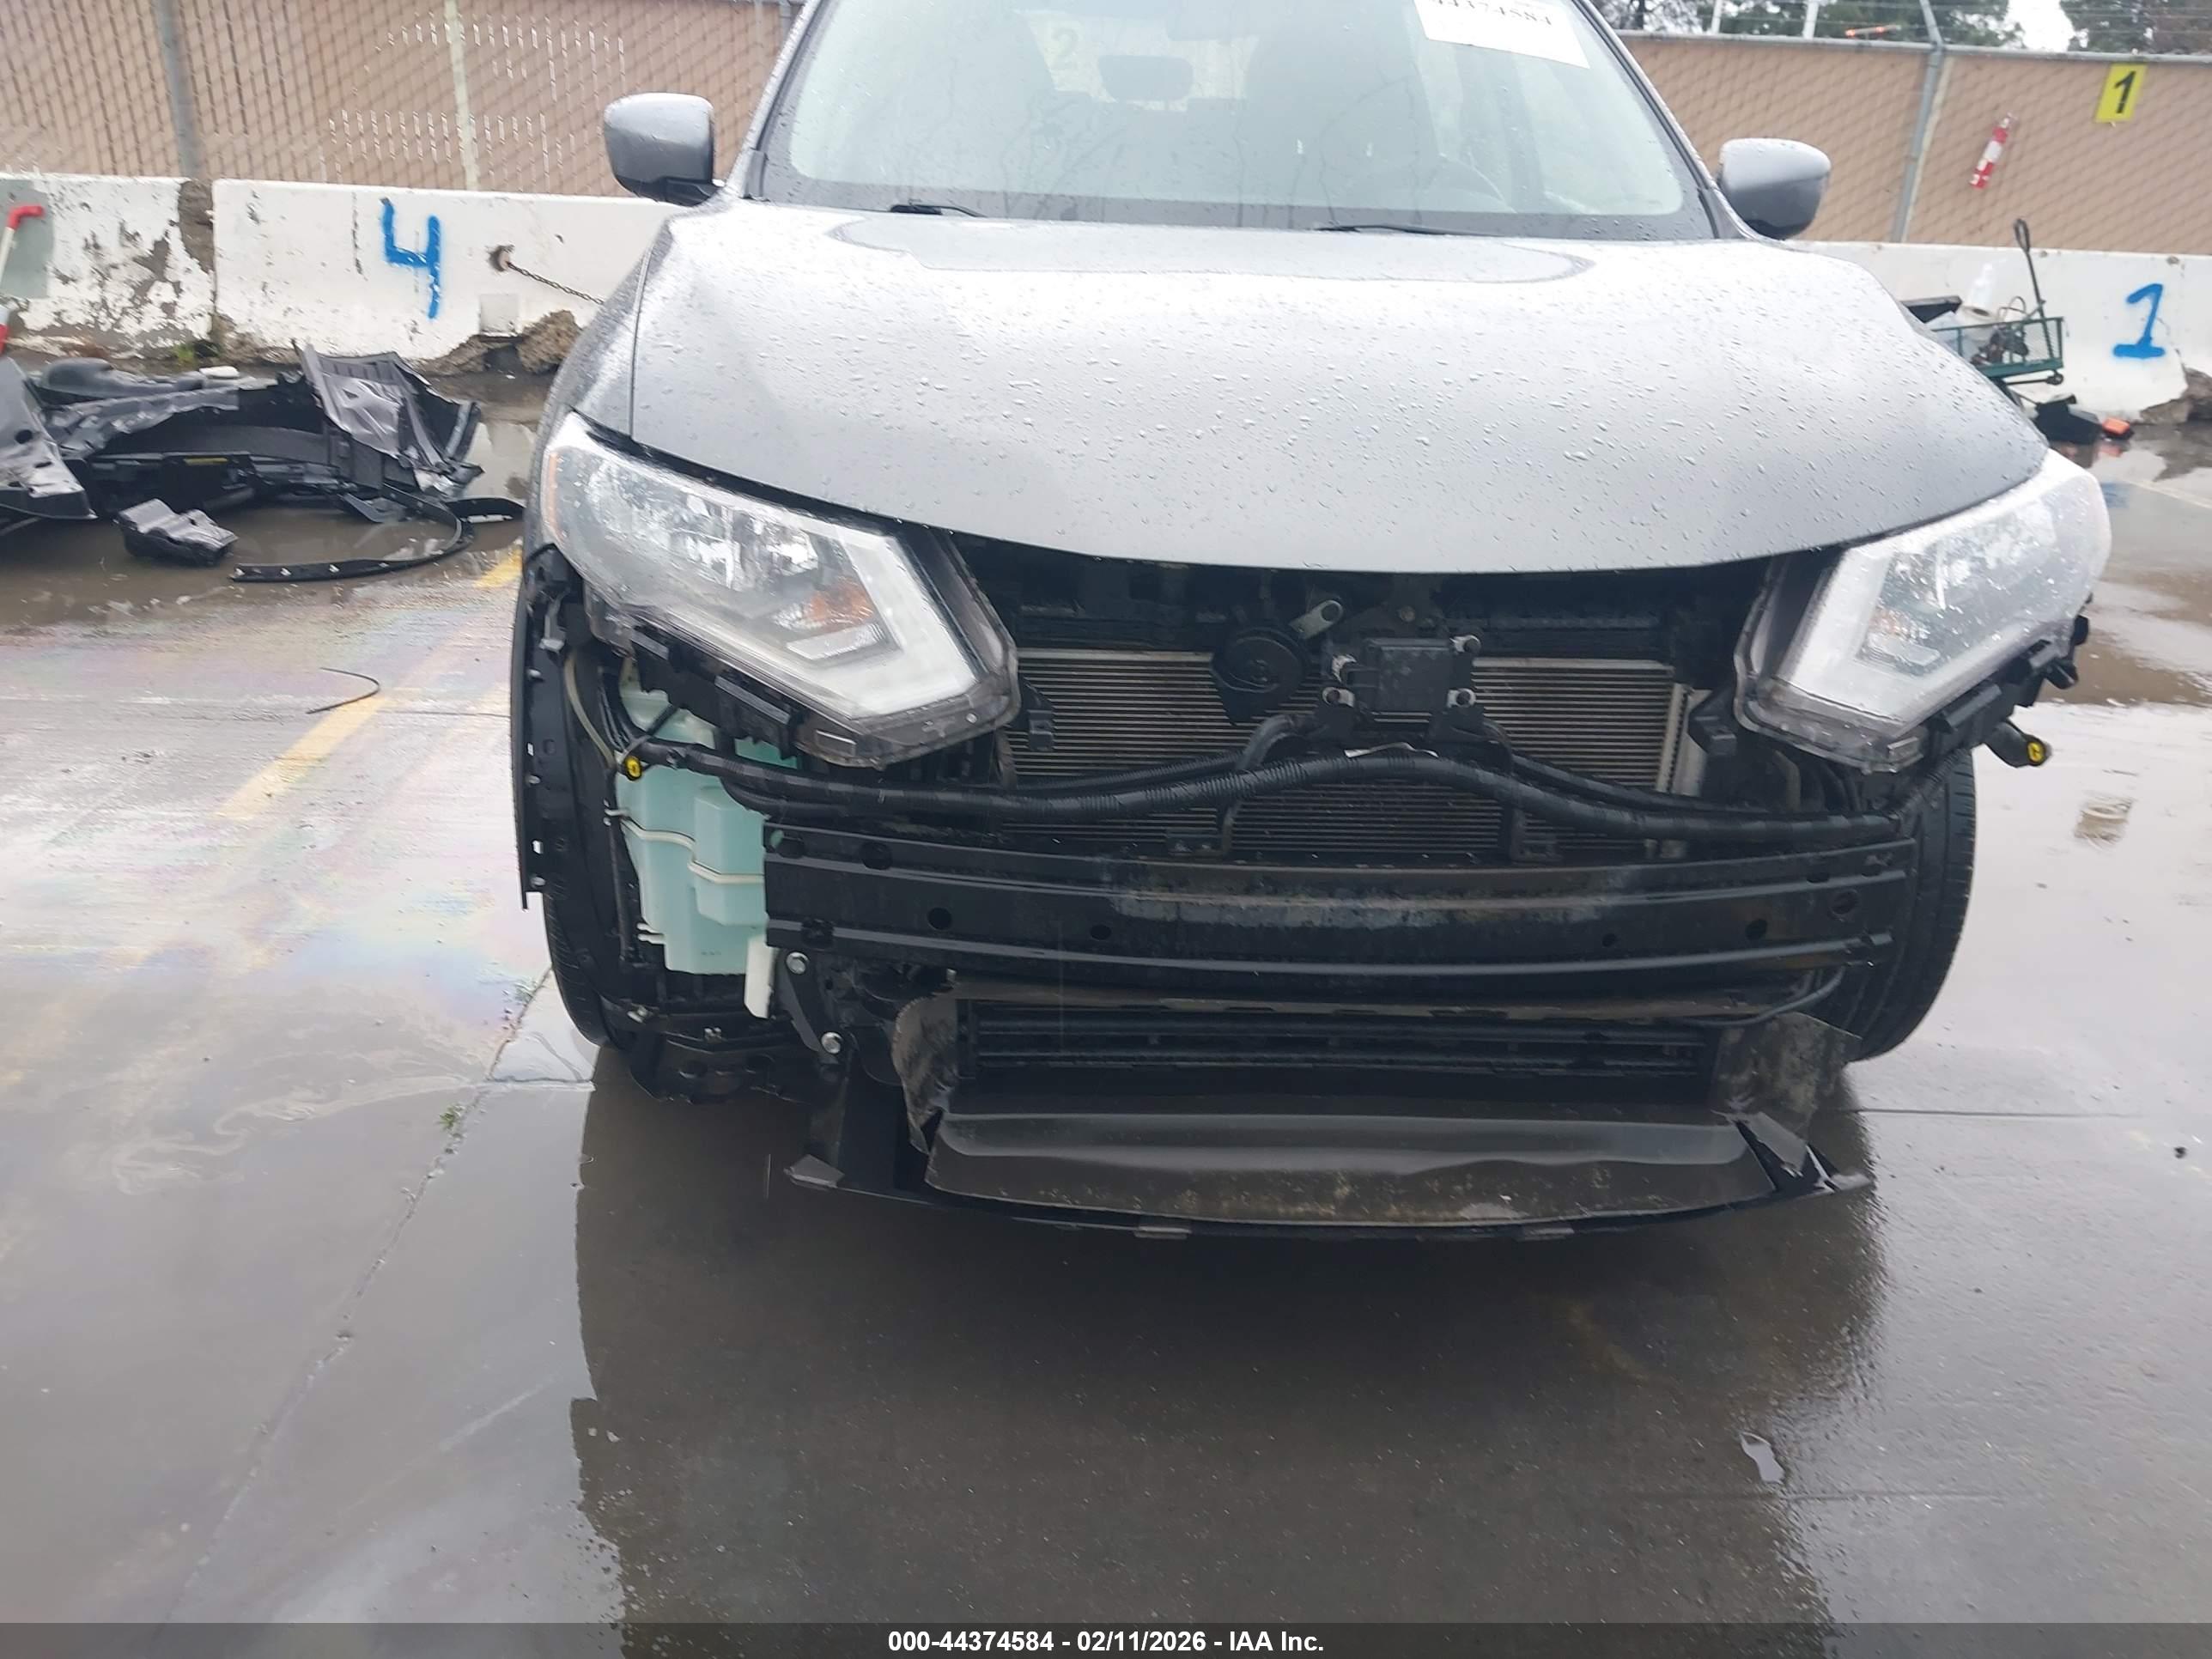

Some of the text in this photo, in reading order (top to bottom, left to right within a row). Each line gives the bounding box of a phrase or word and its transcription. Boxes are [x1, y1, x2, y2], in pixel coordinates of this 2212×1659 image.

[1049, 27, 1079, 70] 2
[2113, 70, 2136, 113] 1
[380, 198, 441, 319] 4
[2112, 283, 2166, 359] 1
